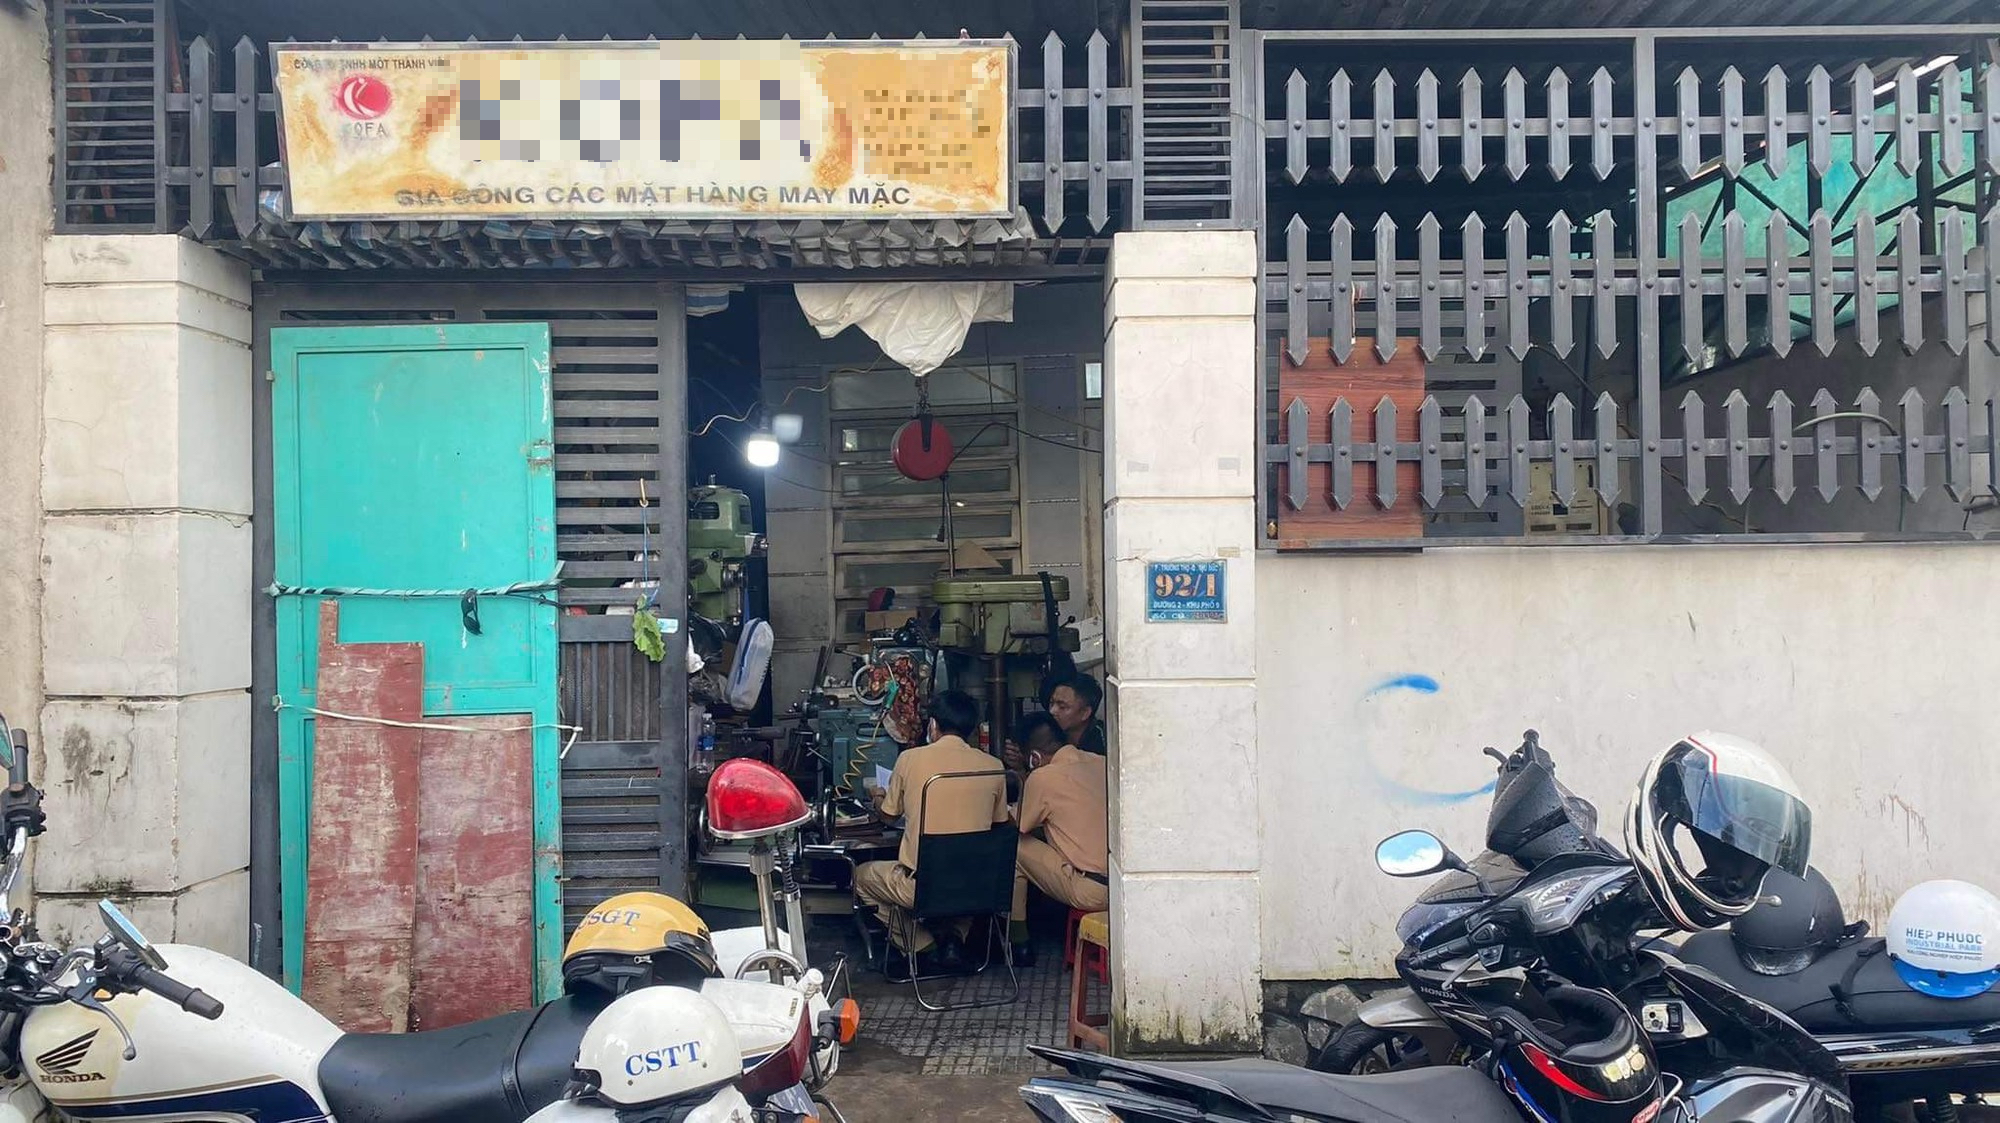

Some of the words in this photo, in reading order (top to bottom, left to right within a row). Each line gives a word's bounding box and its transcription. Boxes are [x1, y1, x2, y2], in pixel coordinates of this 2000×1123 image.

[545, 182, 605, 204] CÁC
[615, 182, 677, 206] MẶT
[686, 182, 768, 204] HÀNG
[779, 186, 837, 204] MAY
[849, 183, 911, 208] MẶC
[1155, 573, 1216, 597] 92/1
[625, 1040, 701, 1076] CSTT
[40, 1072, 106, 1084] HONDA
